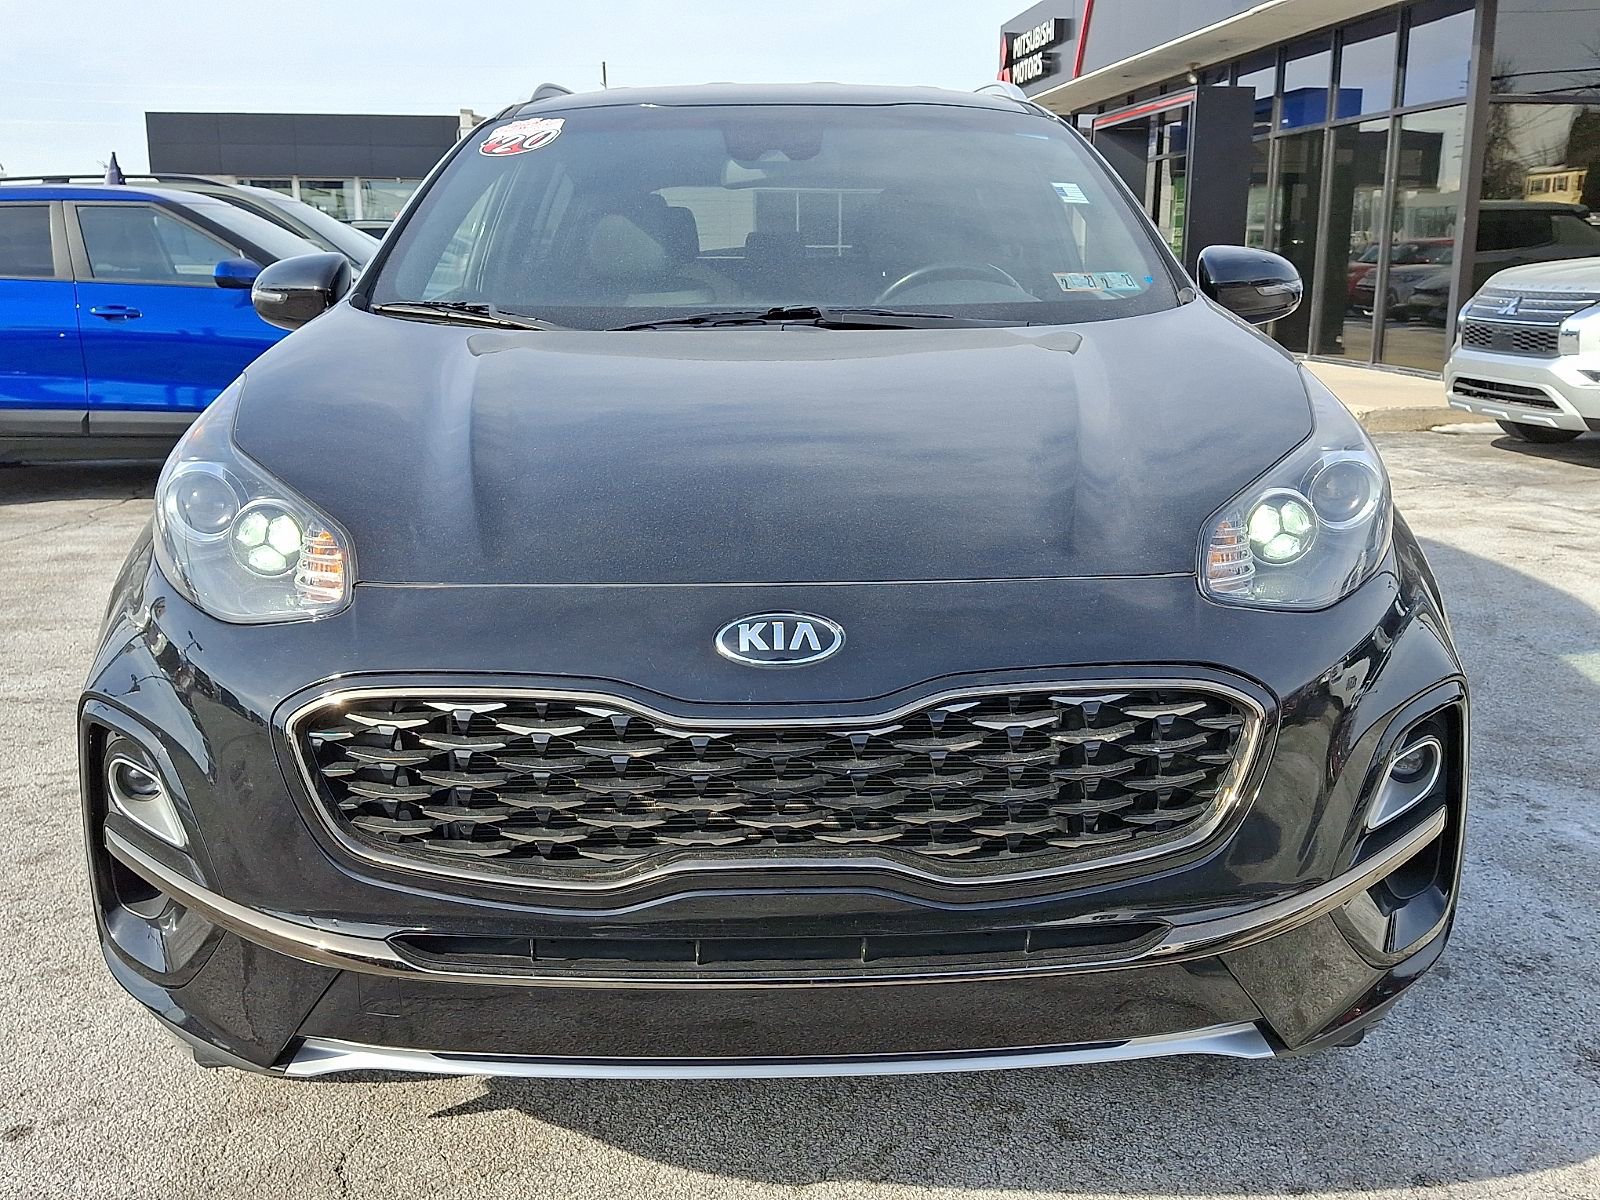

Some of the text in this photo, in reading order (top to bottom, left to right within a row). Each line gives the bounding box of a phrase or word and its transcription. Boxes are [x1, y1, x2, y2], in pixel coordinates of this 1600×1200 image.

[1012, 17, 1055, 60] MITSUBISHI
[1012, 51, 1043, 85] MOTORS
[738, 621, 822, 652] KIA
